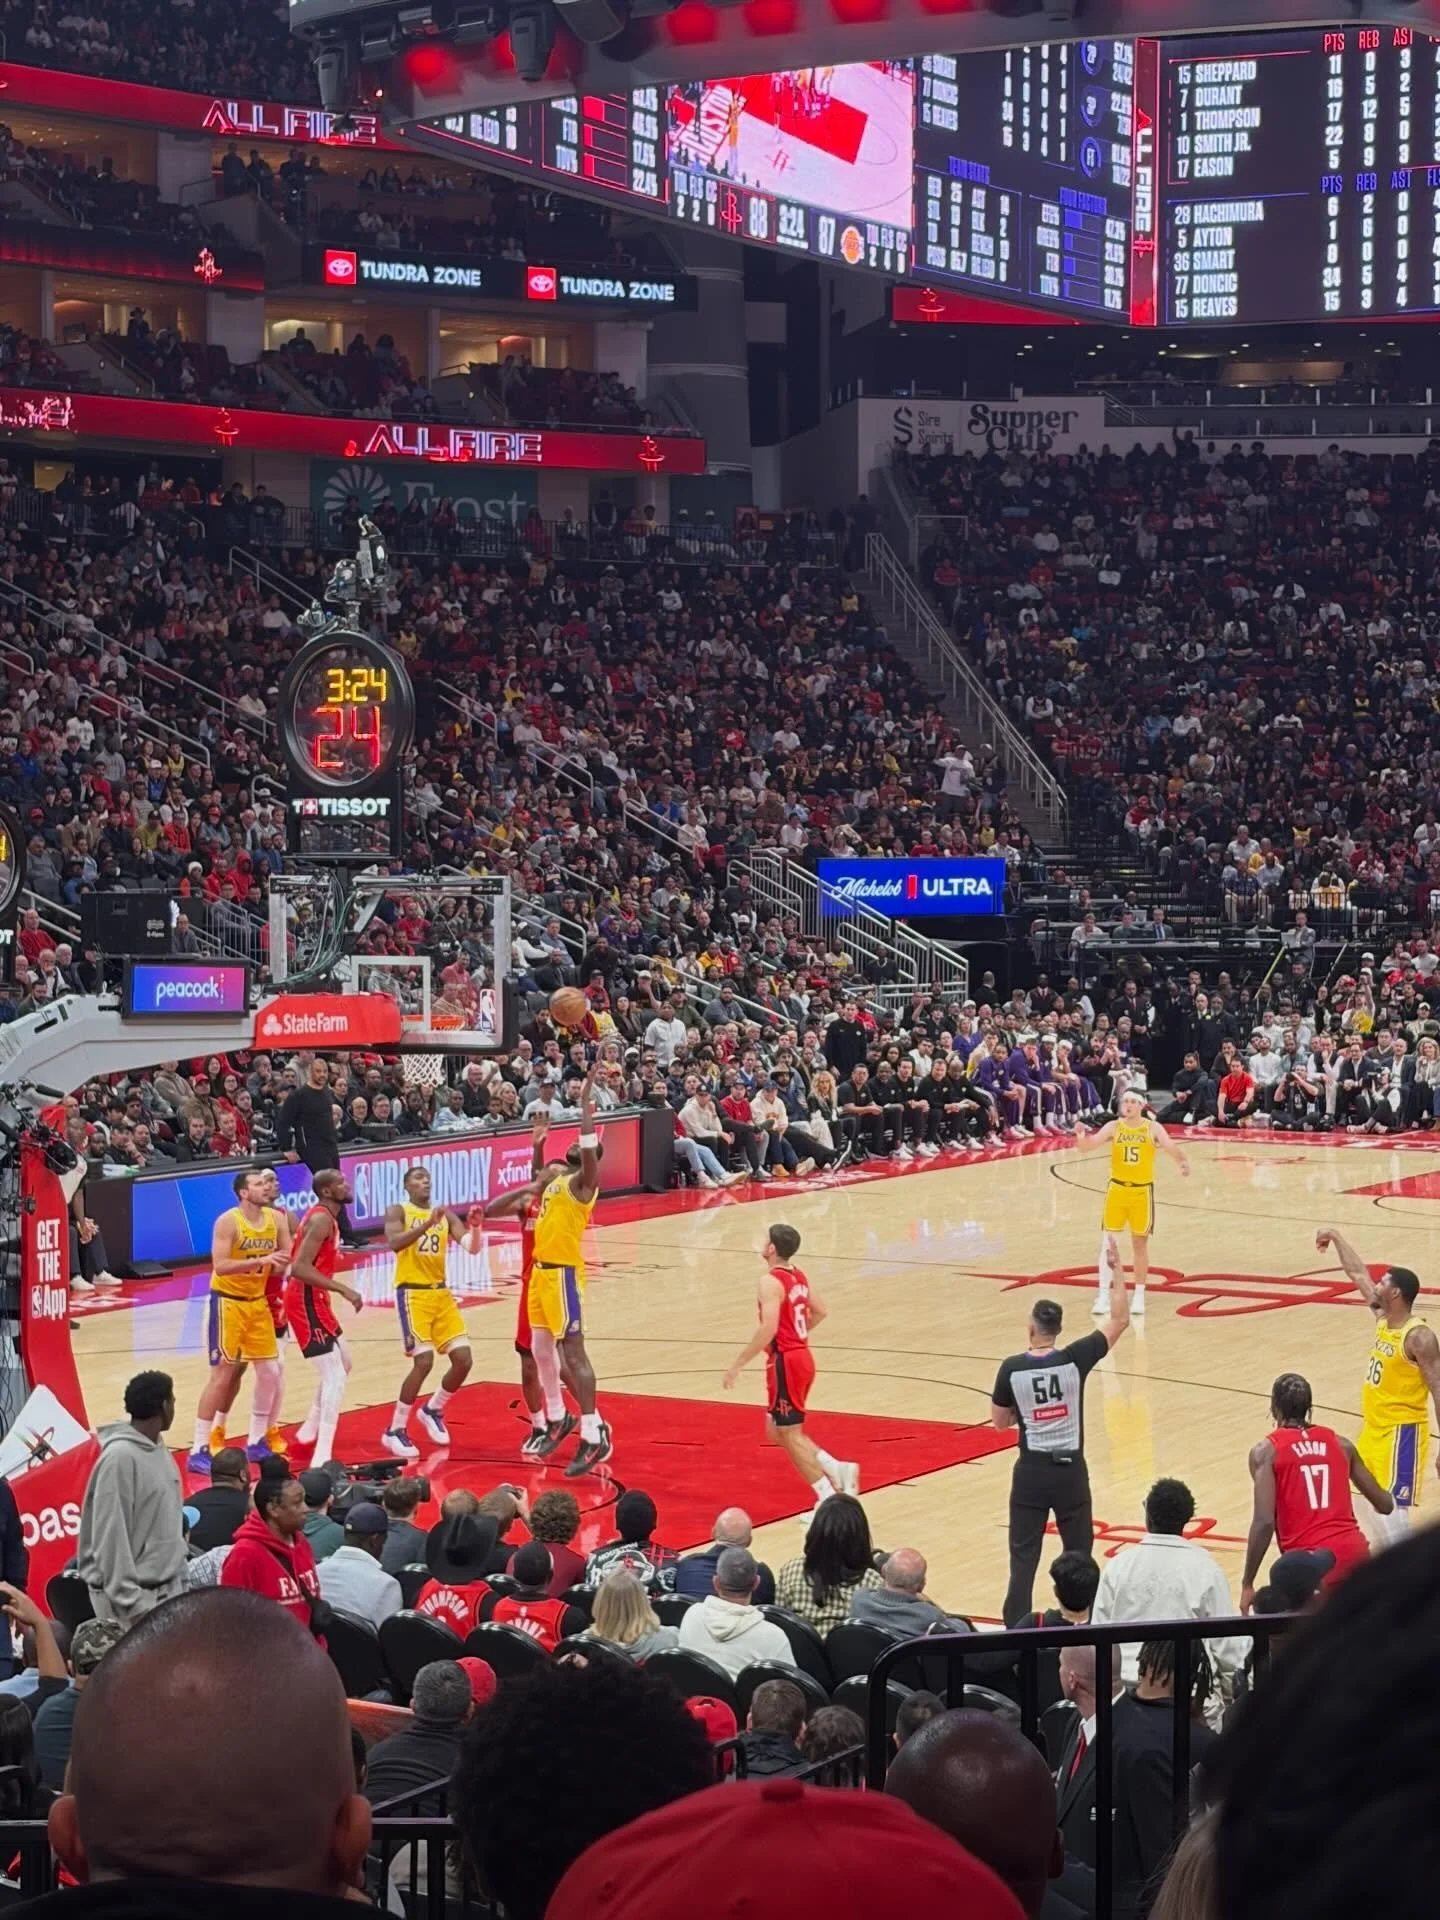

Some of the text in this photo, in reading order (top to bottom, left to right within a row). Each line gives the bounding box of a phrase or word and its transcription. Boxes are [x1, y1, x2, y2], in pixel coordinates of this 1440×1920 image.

[1324, 33, 1345, 51] PTS
[1359, 30, 1379, 48] REB
[1393, 28, 1413, 45] AST
[1178, 66, 1190, 83] 15
[1196, 61, 1257, 82] SHEPPARD
[1330, 55, 1341, 73] 11
[1401, 48, 1410, 67] 3
[1180, 90, 1188, 107] 7
[1195, 86, 1242, 107] DURANT
[1328, 79, 1342, 98] 16
[1365, 76, 1375, 95] 5
[1400, 73, 1410, 92] 2
[202, 100, 279, 134] ALL
[1181, 114, 1187, 130] 1
[1195, 108, 1260, 129] THOMPSON
[1328, 102, 1342, 121] 17
[1362, 100, 1377, 119] 12
[1400, 97, 1409, 115] 5
[1177, 136, 1189, 154] 10
[1194, 134, 1233, 153] SMITH
[1234, 132, 1251, 152] JR.
[1325, 127, 1343, 145] 22
[1400, 121, 1409, 139] 0
[1177, 160, 1189, 178] 17
[1194, 157, 1233, 176] EASON
[1329, 150, 1338, 169] 5
[1364, 147, 1374, 166] 9
[1399, 145, 1409, 163] 3
[1321, 176, 1342, 193] PTS
[1356, 173, 1377, 191] REB
[1391, 170, 1412, 188] AST
[1135, 167, 1152, 232] FIRE
[1175, 206, 1190, 224] 28
[1193, 201, 1264, 223] HACHIMURA
[1328, 197, 1338, 216] 6
[1363, 194, 1372, 213] 2
[779, 204, 805, 239] 3:24
[819, 216, 835, 255] 87
[1178, 229, 1187, 248] 5
[1193, 227, 1233, 247] AYTON
[1329, 221, 1336, 239] 1
[360, 261, 481, 287] TUNDRA ZONE
[1174, 253, 1189, 271] 36
[1193, 250, 1235, 270] SMART
[561, 277, 674, 300] TUNDRA ZONE
[1175, 276, 1188, 294] 77
[1192, 273, 1238, 294] DONCIC
[1323, 268, 1341, 287] 34
[1363, 265, 1372, 284] 5
[1397, 263, 1407, 282] 4
[1175, 300, 1188, 318] 15
[1192, 298, 1237, 317] REAVES
[1324, 292, 1340, 311] 15
[1362, 289, 1372, 308] 3
[1396, 286, 1407, 305] 4
[918, 411, 940, 426] Sire
[968, 404, 1078, 435] Supper
[365, 424, 542, 462] ALL FIRE
[987, 426, 1053, 451] Club
[402, 481, 526, 522] Frost
[328, 668, 387, 702] 3:24
[314, 706, 380, 768] 24
[319, 798, 390, 816] TISSOT
[831, 876, 992, 898] Michelob ULTRA
[156, 976, 219, 1007] peacock
[282, 1012, 348, 1034] StateFarm
[1124, 1146, 1139, 1162] 15
[37, 1219, 60, 1251] GET
[418, 1234, 440, 1252] 28
[37, 1250, 61, 1283] THE
[43, 1284, 67, 1321] App
[1032, 1374, 1063, 1404] 54
[1292, 1441, 1326, 1457] EASON
[1300, 1464, 1328, 1509] 17
